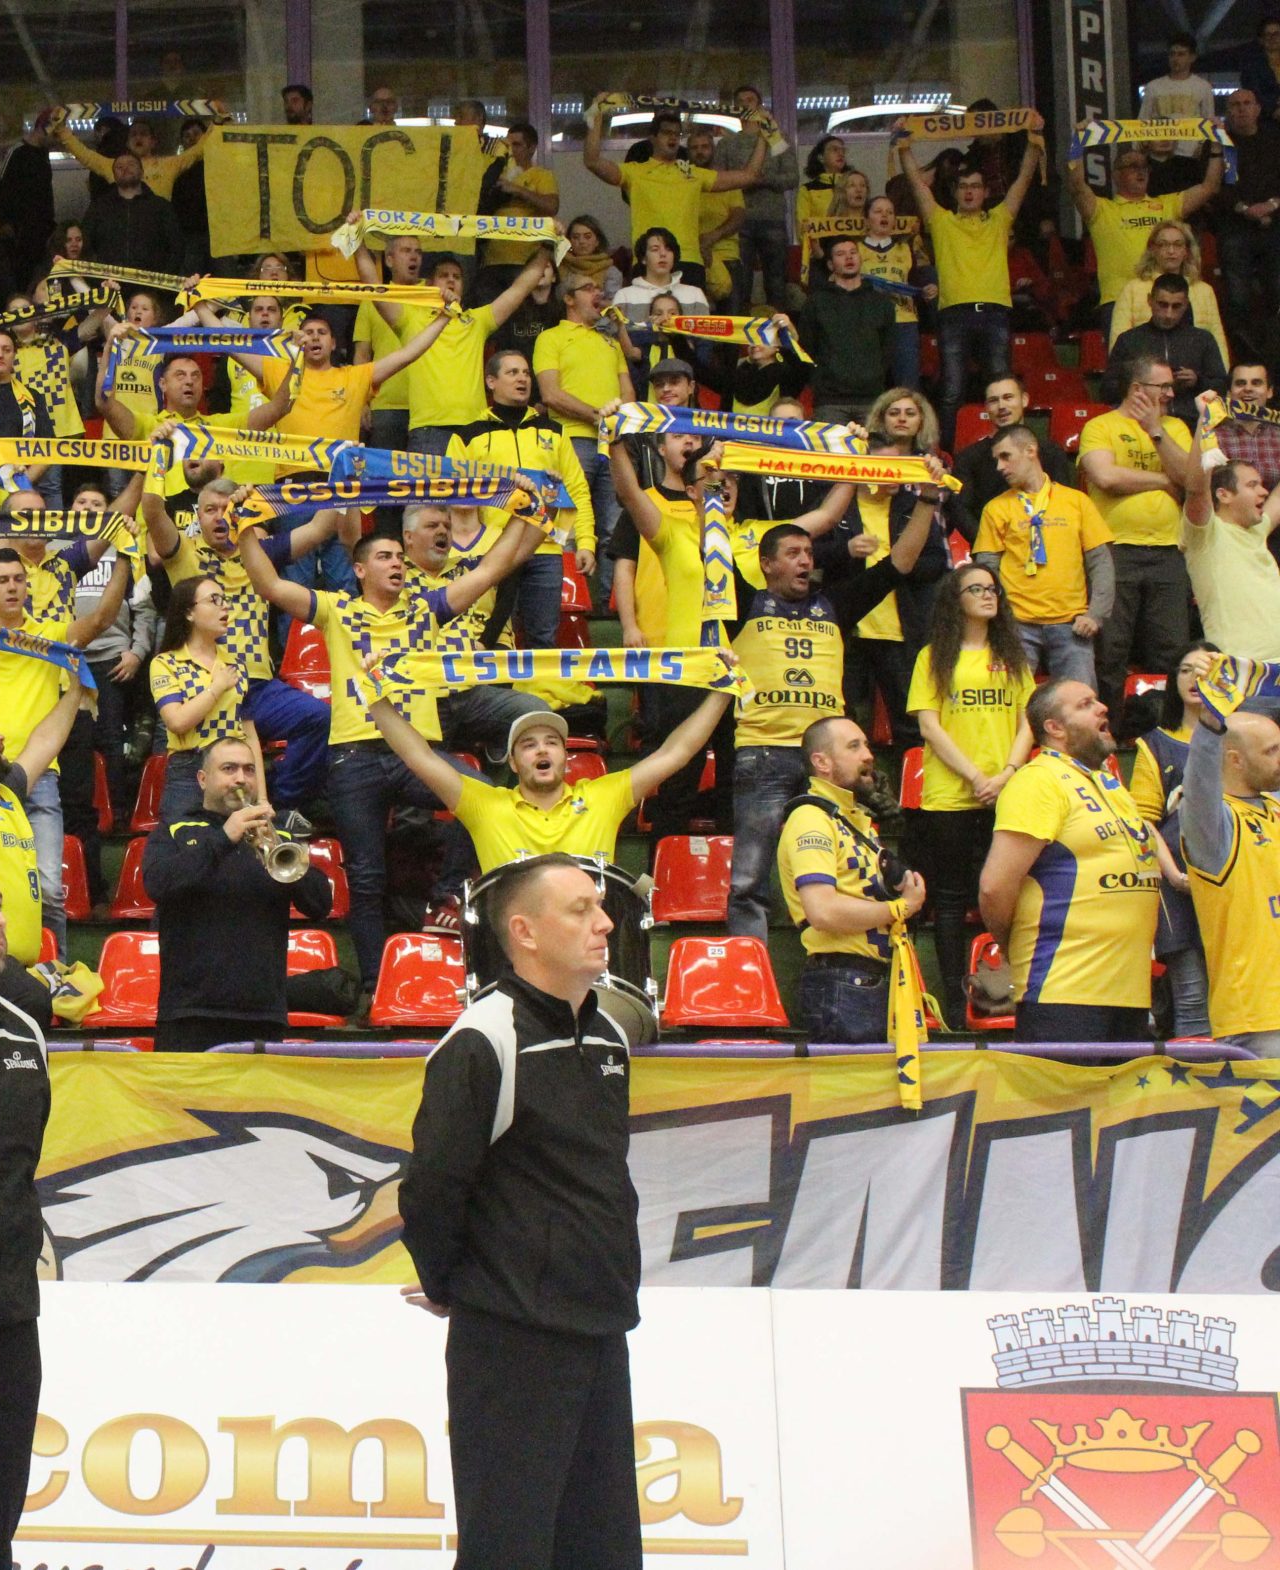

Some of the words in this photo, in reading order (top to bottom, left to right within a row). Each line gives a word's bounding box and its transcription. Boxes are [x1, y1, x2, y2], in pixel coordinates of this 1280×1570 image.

[111, 101, 132, 112] HAI
[136, 101, 167, 112] CSU!
[924, 116, 965, 133] CSU
[974, 108, 1028, 130] SIBIU
[1124, 127, 1200, 138] BASKETBALL
[366, 209, 435, 229] FORZA
[477, 215, 545, 231] SIBIU
[834, 218, 863, 233] CSU
[43, 285, 111, 313] SIBIU
[172, 332, 203, 346] HAI
[208, 333, 254, 347] CSU!
[691, 410, 729, 430] HAI
[732, 414, 786, 438] CSU!
[236, 428, 288, 446] SIBIU
[15, 440, 51, 458] HAI
[56, 441, 96, 458] CSU
[101, 442, 152, 464] SIBIU
[215, 442, 311, 463] BASKETBALL
[391, 449, 442, 478] CSU
[281, 481, 361, 505] CSU
[386, 478, 499, 499] SIBIU
[10, 510, 105, 536] SIBIU
[756, 620, 773, 632] BC
[806, 620, 835, 637] SIBIU
[784, 637, 813, 659] 99
[441, 652, 535, 684] CSU
[559, 650, 684, 681] FANS
[754, 690, 837, 709] compa
[962, 689, 1013, 707] SIBIU
[1075, 786, 1102, 812] 5
[1094, 821, 1117, 841] BC
[797, 837, 833, 848] UNIMAT
[710, 946, 724, 956] 25
